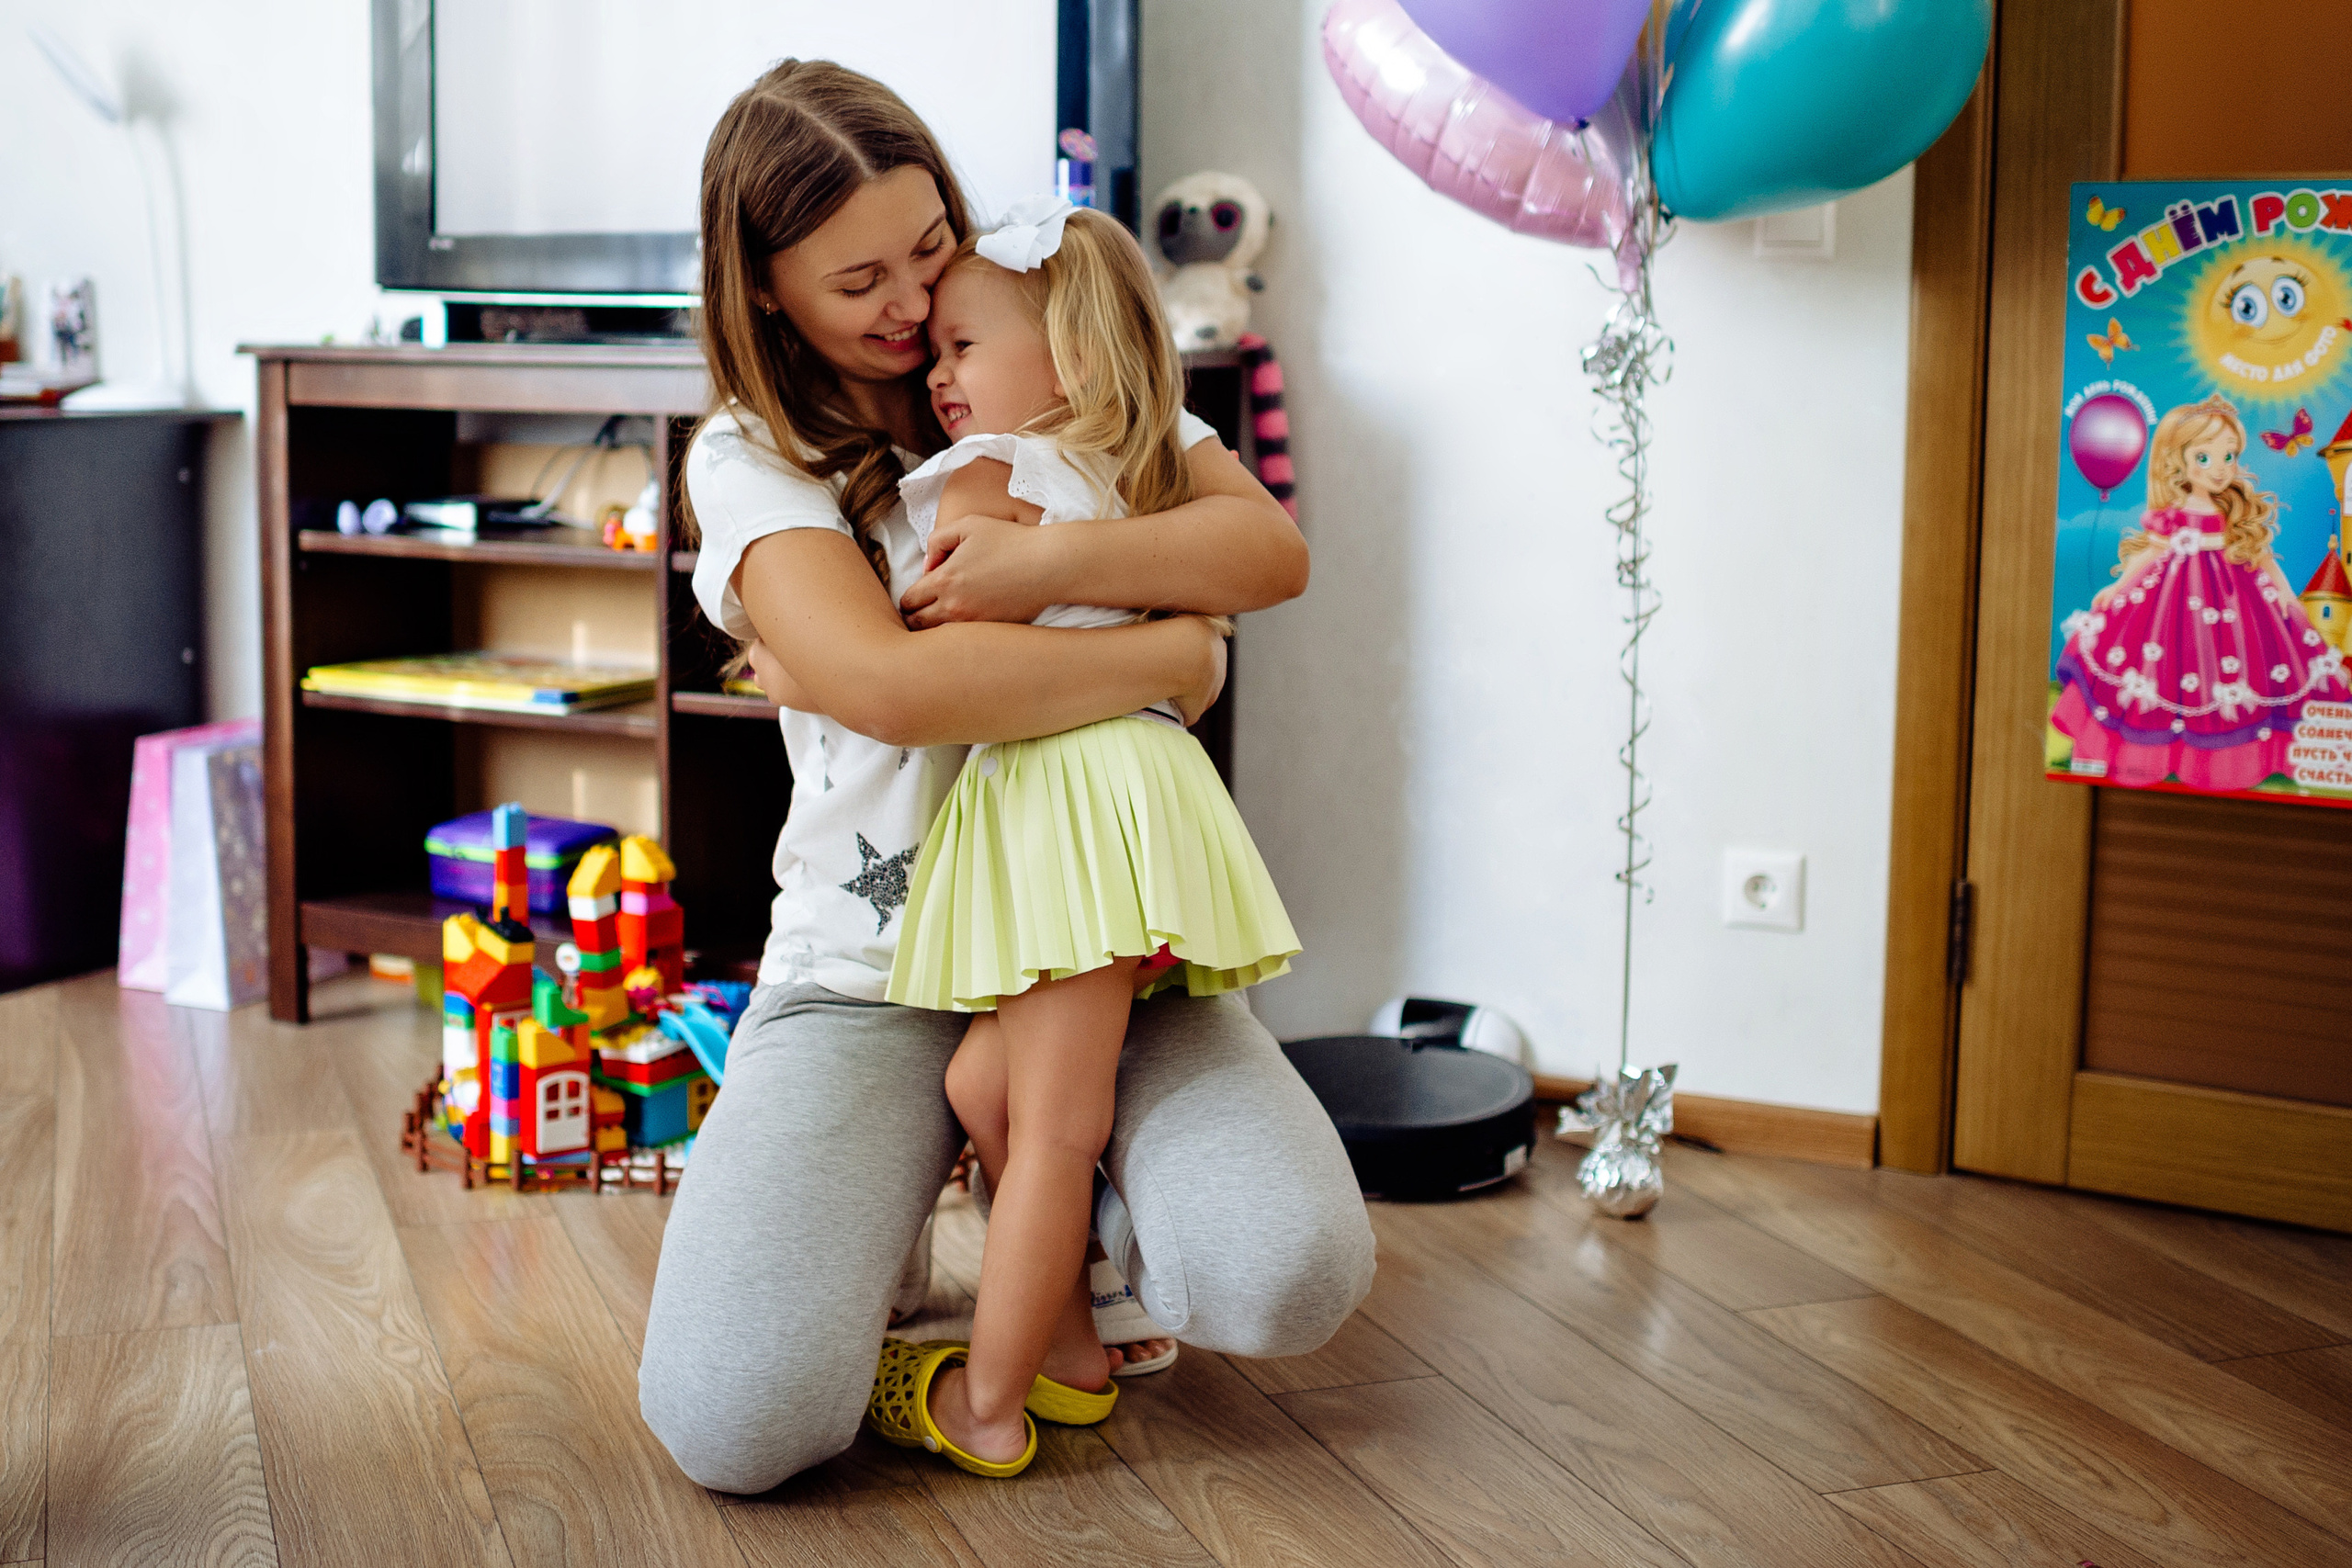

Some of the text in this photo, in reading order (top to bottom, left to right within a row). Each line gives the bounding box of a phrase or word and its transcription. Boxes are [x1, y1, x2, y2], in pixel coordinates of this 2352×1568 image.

[2077, 267, 2116, 307] С
[2108, 196, 2242, 296] ДНЁМ
[2292, 747, 2337, 761] ПУСТЬ
